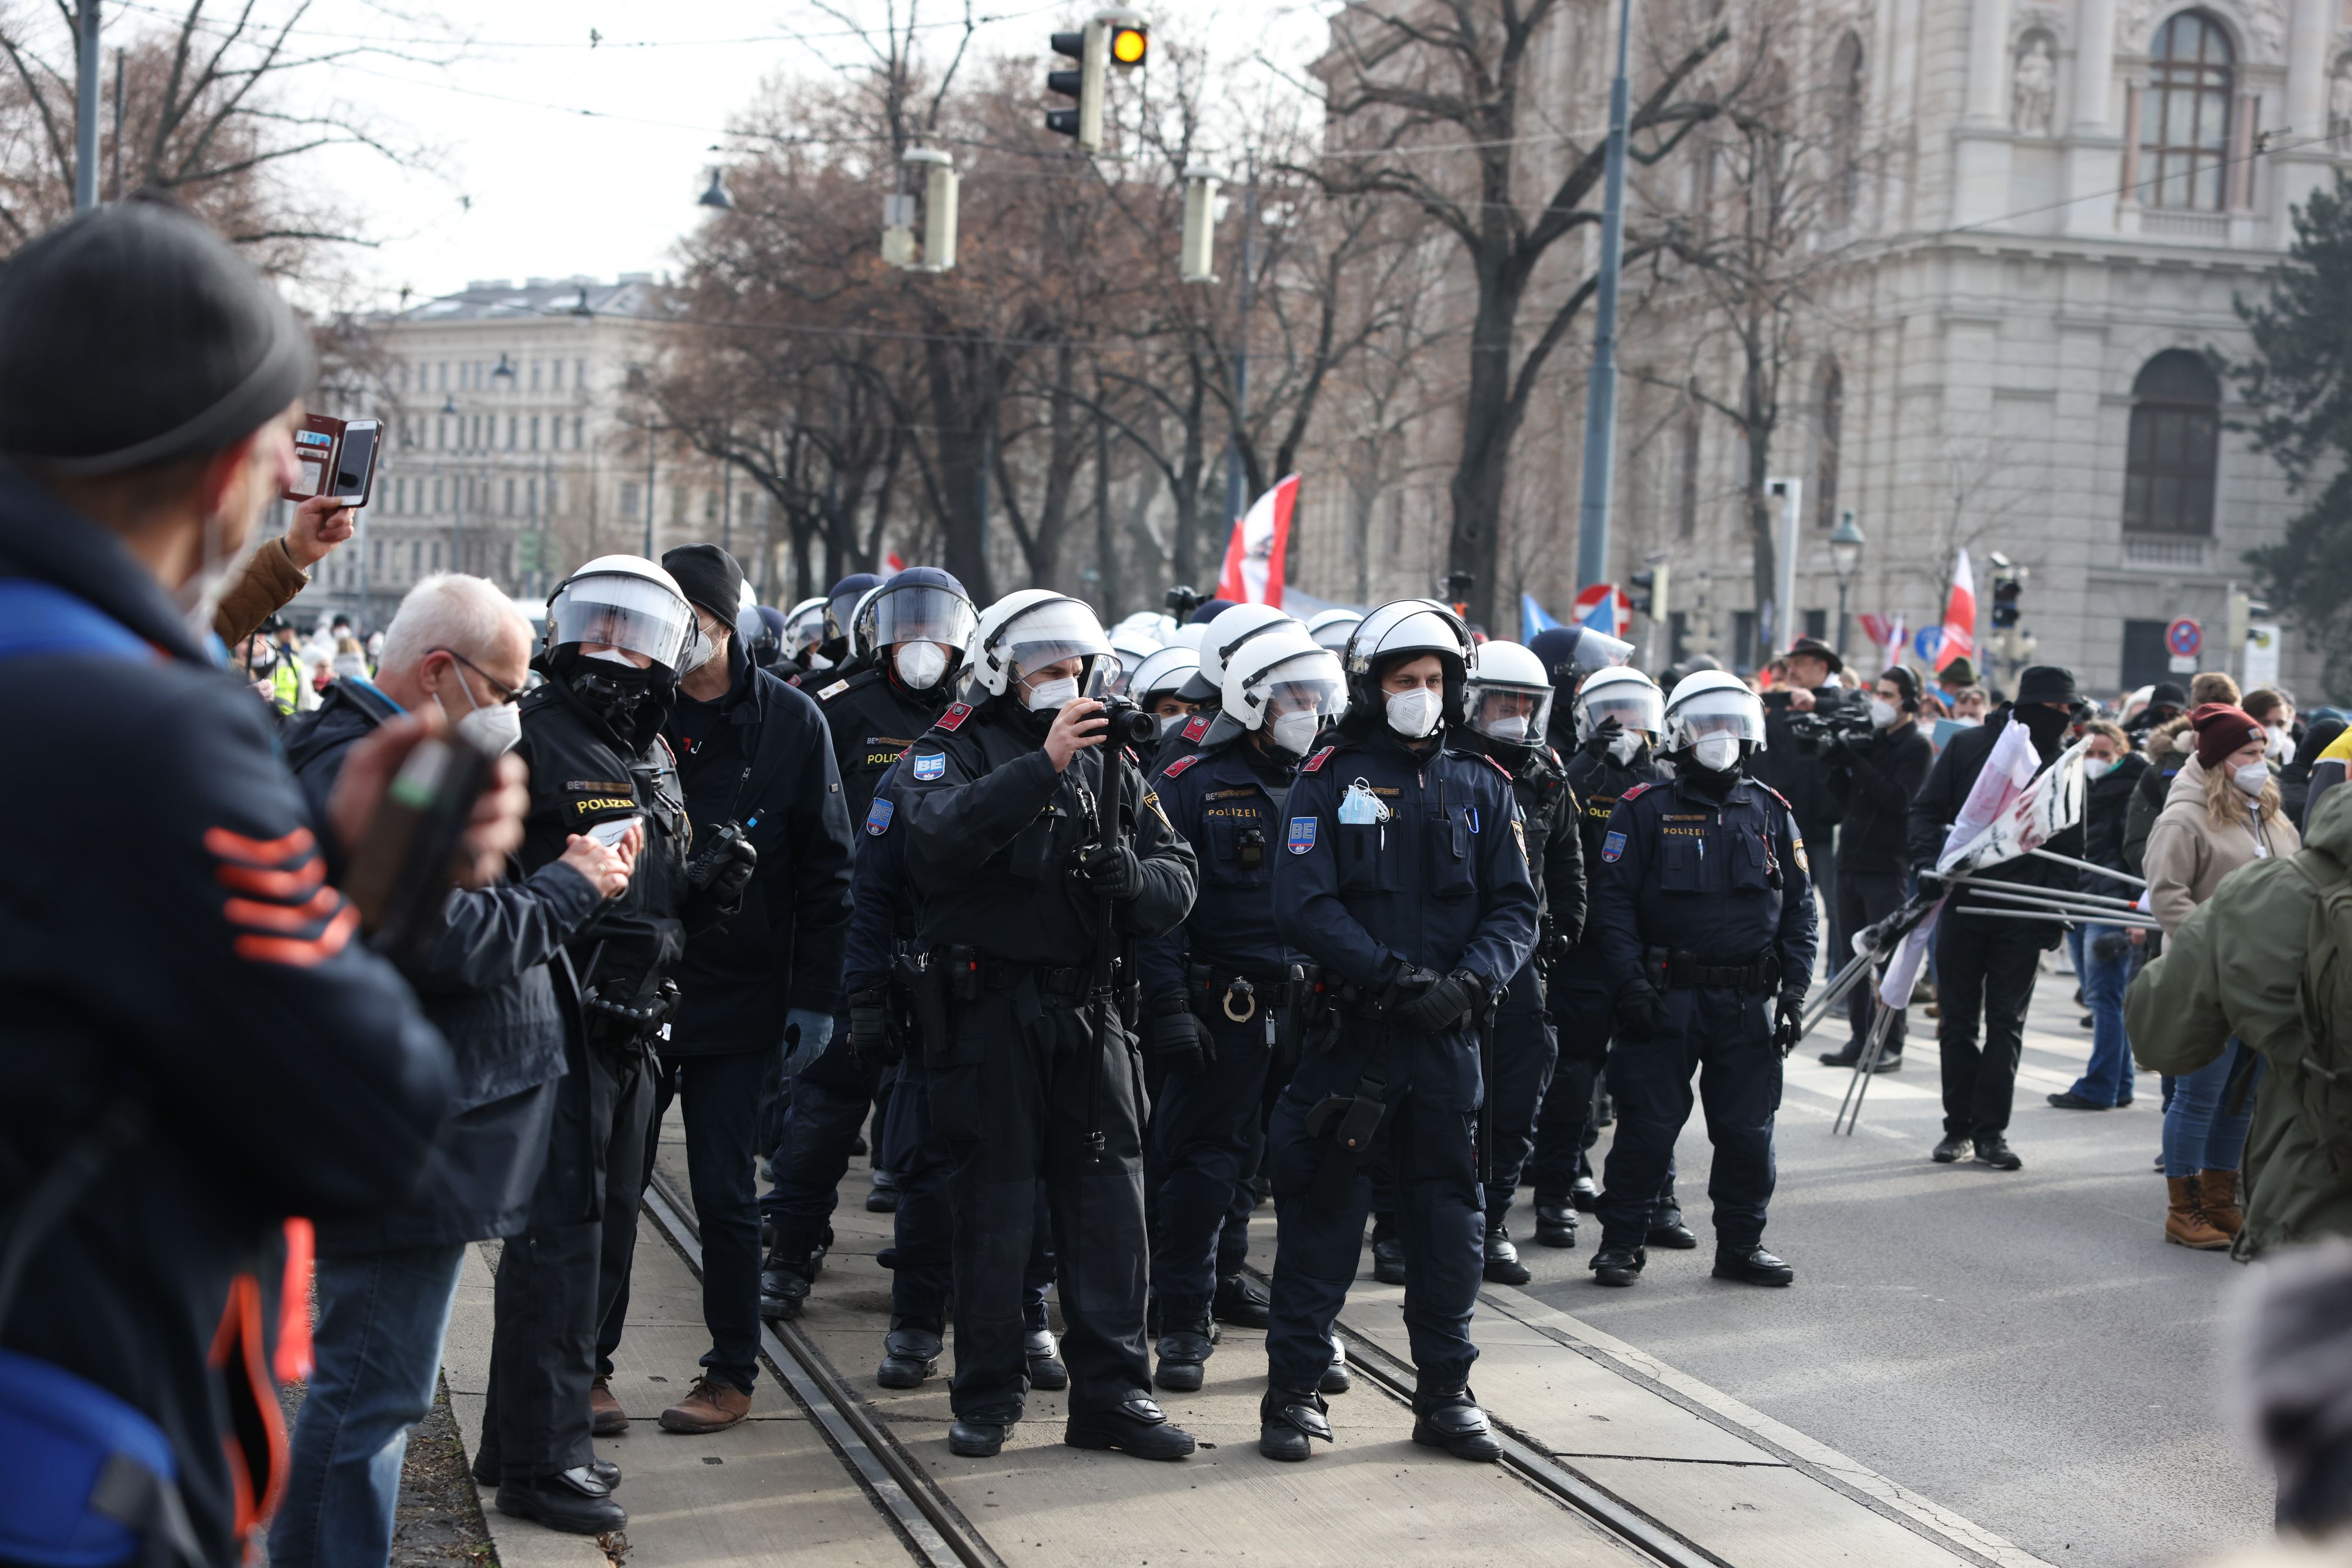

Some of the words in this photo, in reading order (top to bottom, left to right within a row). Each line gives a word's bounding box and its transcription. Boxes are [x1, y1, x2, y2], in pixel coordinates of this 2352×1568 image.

[867, 754, 898, 764] POLIZ
[917, 758, 943, 771] BE
[576, 798, 635, 814] POLIZEI
[871, 803, 892, 822] BE
[1208, 808, 1257, 817] POLIZEI
[1589, 807, 1612, 818] OLIZ
[1291, 823, 1314, 839] BE
[1663, 828, 1705, 836] POLIZEI
[1605, 836, 1624, 851] BE
